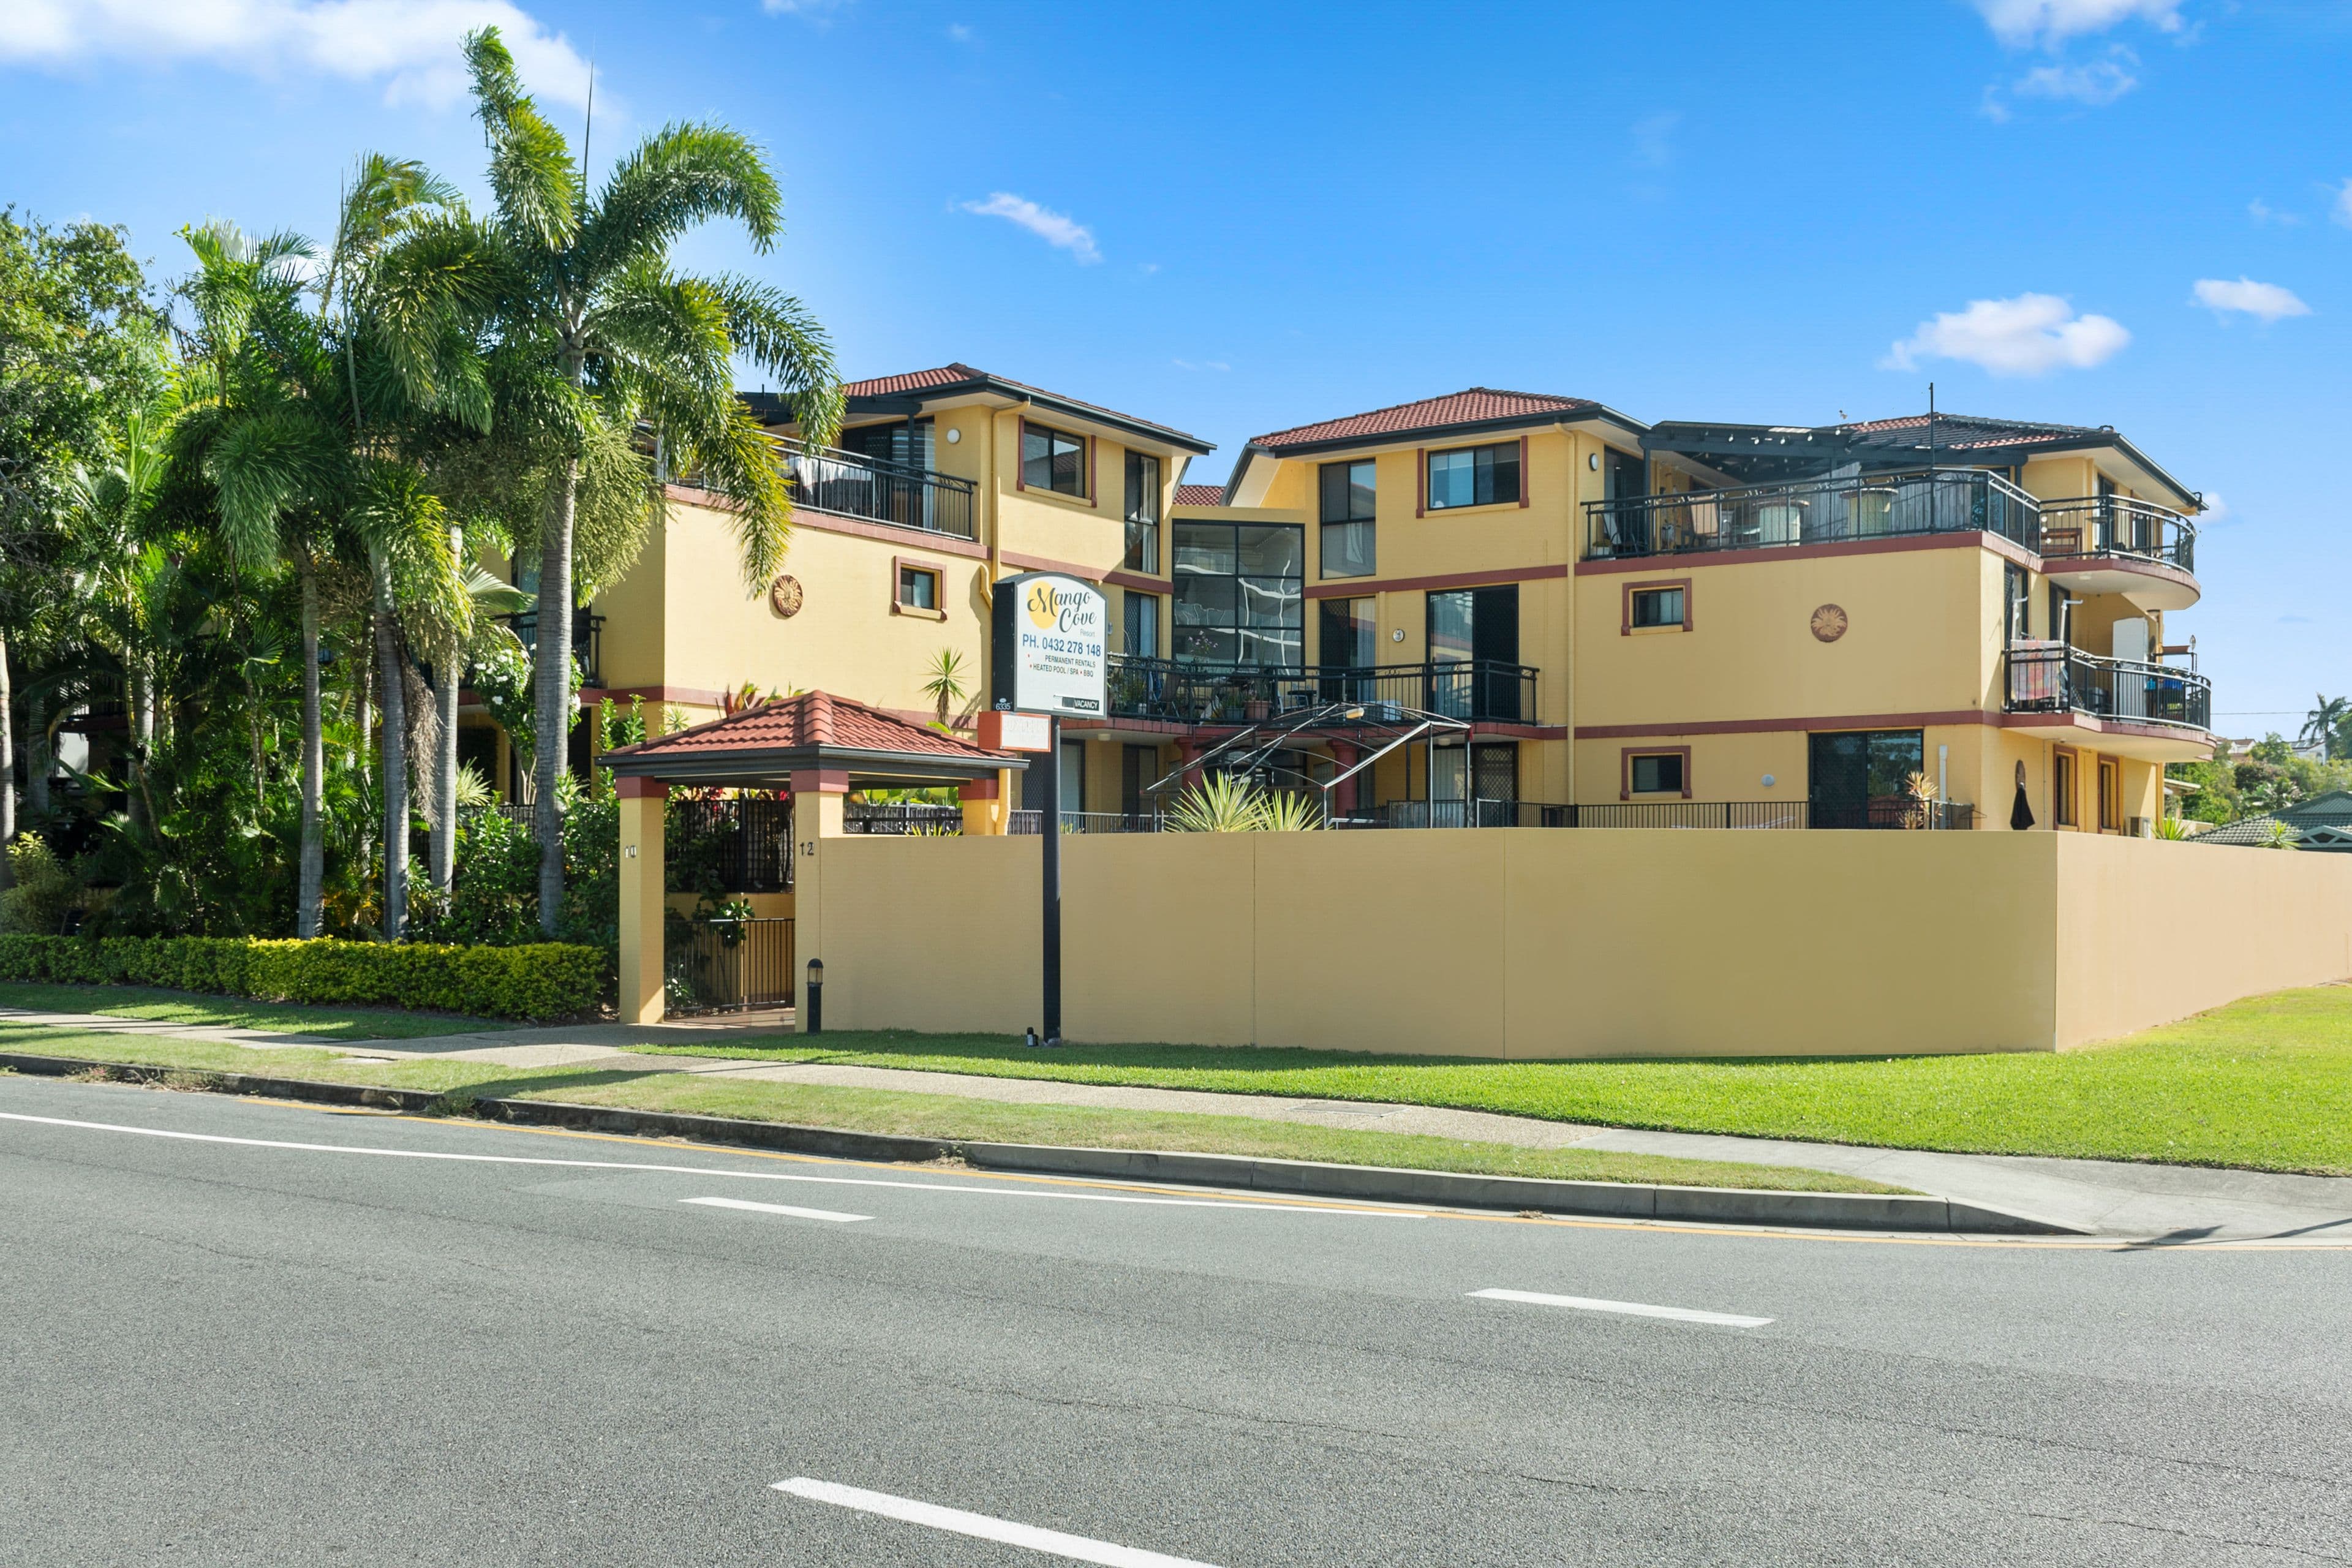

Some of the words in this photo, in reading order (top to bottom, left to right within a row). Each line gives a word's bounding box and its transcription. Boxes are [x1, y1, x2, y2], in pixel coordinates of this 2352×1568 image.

[1027, 587, 1092, 617] Mango
[1059, 608, 1097, 633] Cove
[1080, 628, 1095, 638] Resort
[1022, 634, 1039, 649] PH.
[1042, 636, 1065, 652] 0432
[1067, 640, 1083, 655] 278
[1087, 644, 1101, 657] 148
[1045, 655, 1074, 666] PERMANENT
[1075, 658, 1096, 668] RENTALS
[1033, 663, 1052, 673] HEATED
[1054, 666, 1066, 674] POOL
[1074, 699, 1098, 709] VACANCY
[800, 842, 814, 856] 12
